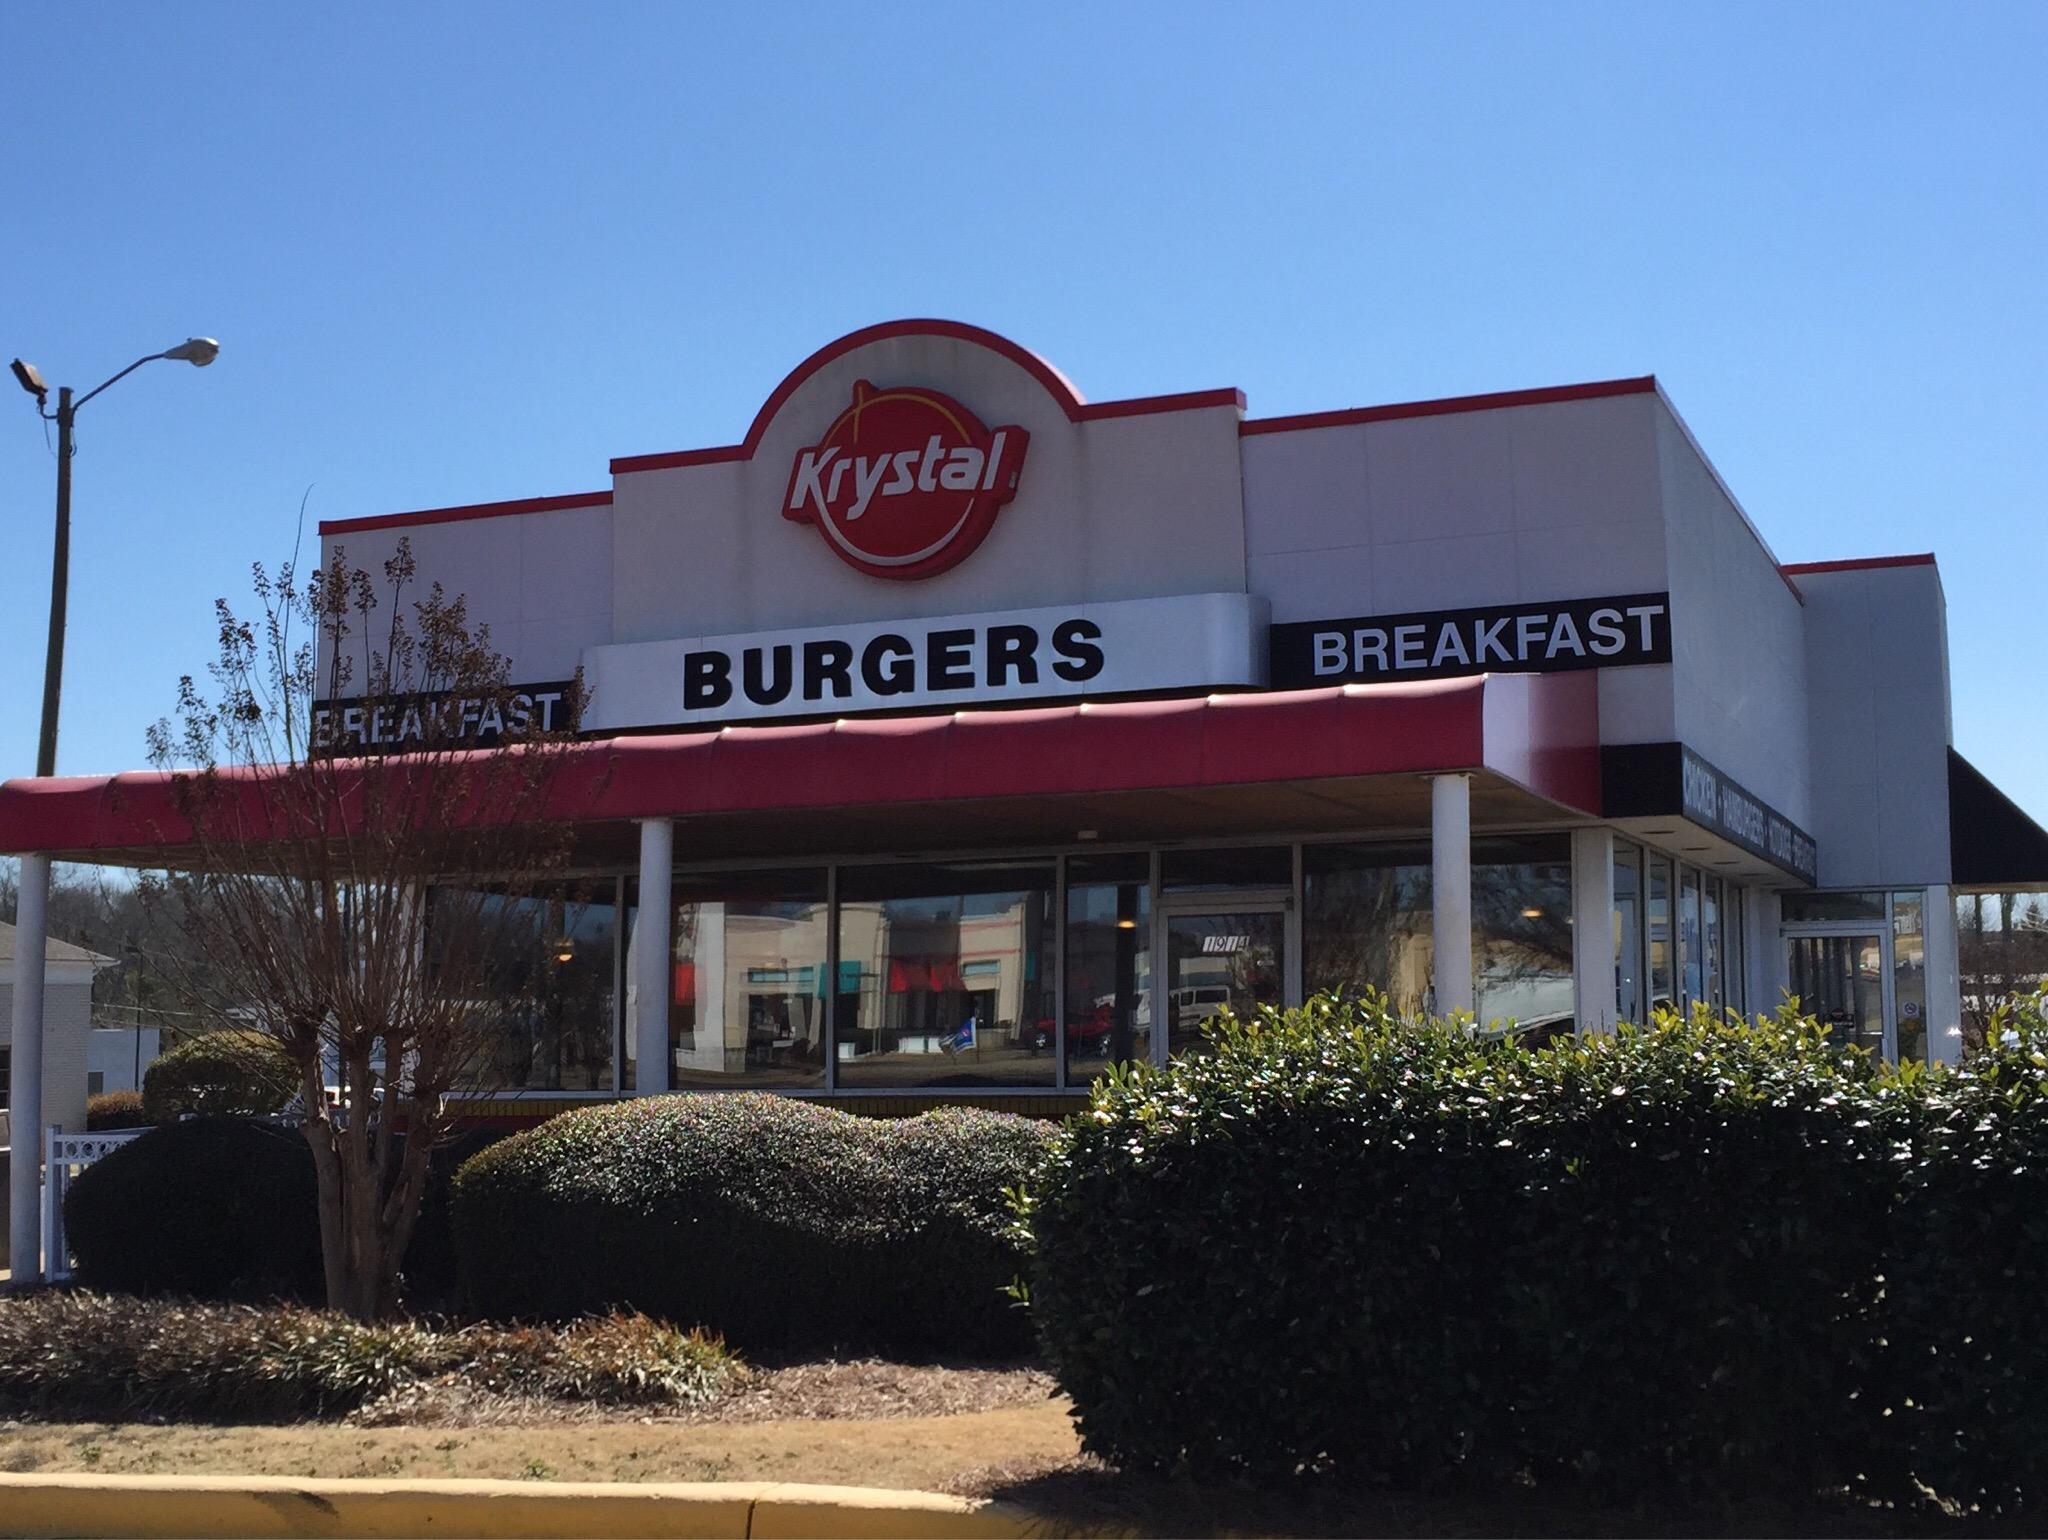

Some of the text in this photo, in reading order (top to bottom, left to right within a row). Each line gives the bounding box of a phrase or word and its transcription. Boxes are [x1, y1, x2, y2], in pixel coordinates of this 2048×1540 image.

[789, 431, 1007, 521] Krystal
[683, 618, 1105, 710] BURGERS
[1313, 604, 1664, 677] BREAKFAST
